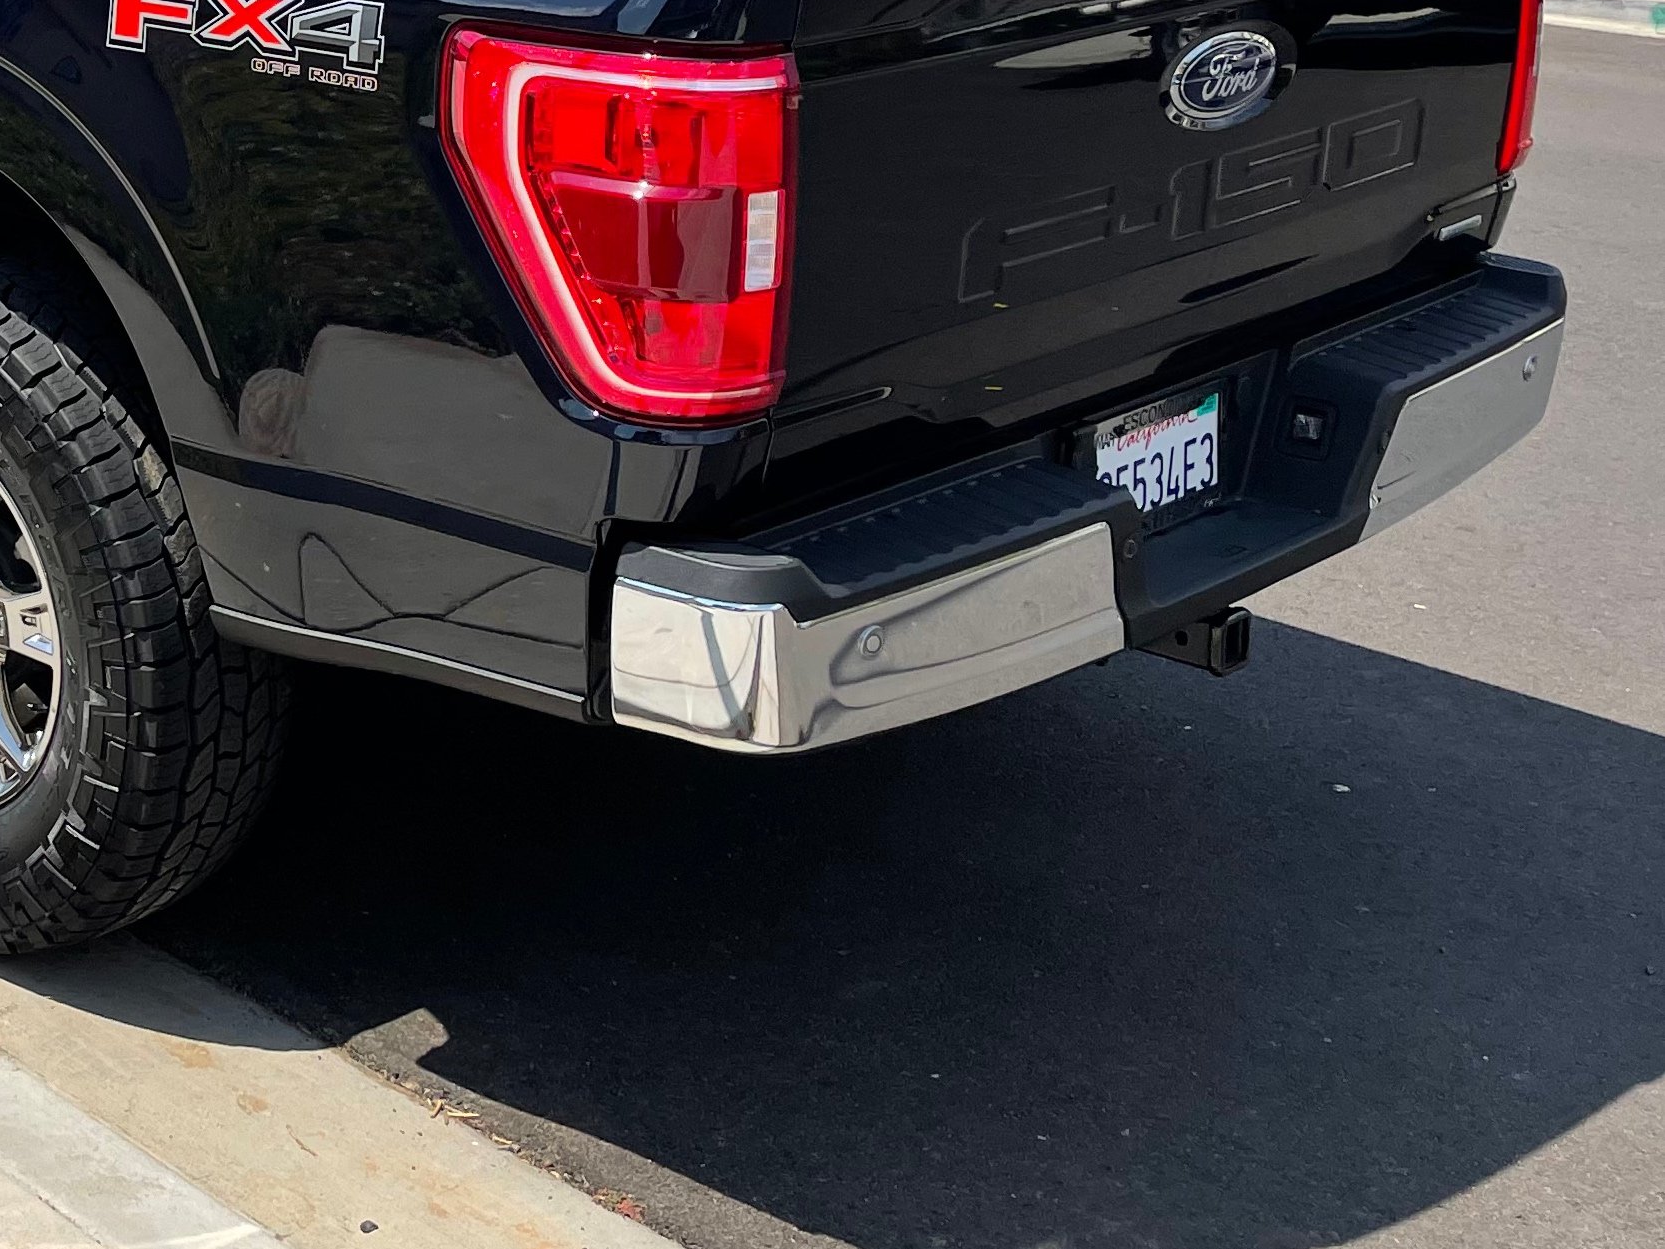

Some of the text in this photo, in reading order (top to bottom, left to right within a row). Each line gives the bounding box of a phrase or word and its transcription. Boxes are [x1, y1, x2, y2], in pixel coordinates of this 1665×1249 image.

[251, 58, 379, 92] OFF ROAD
[1201, 42, 1260, 102] Ford
[958, 98, 1435, 304] F-150
